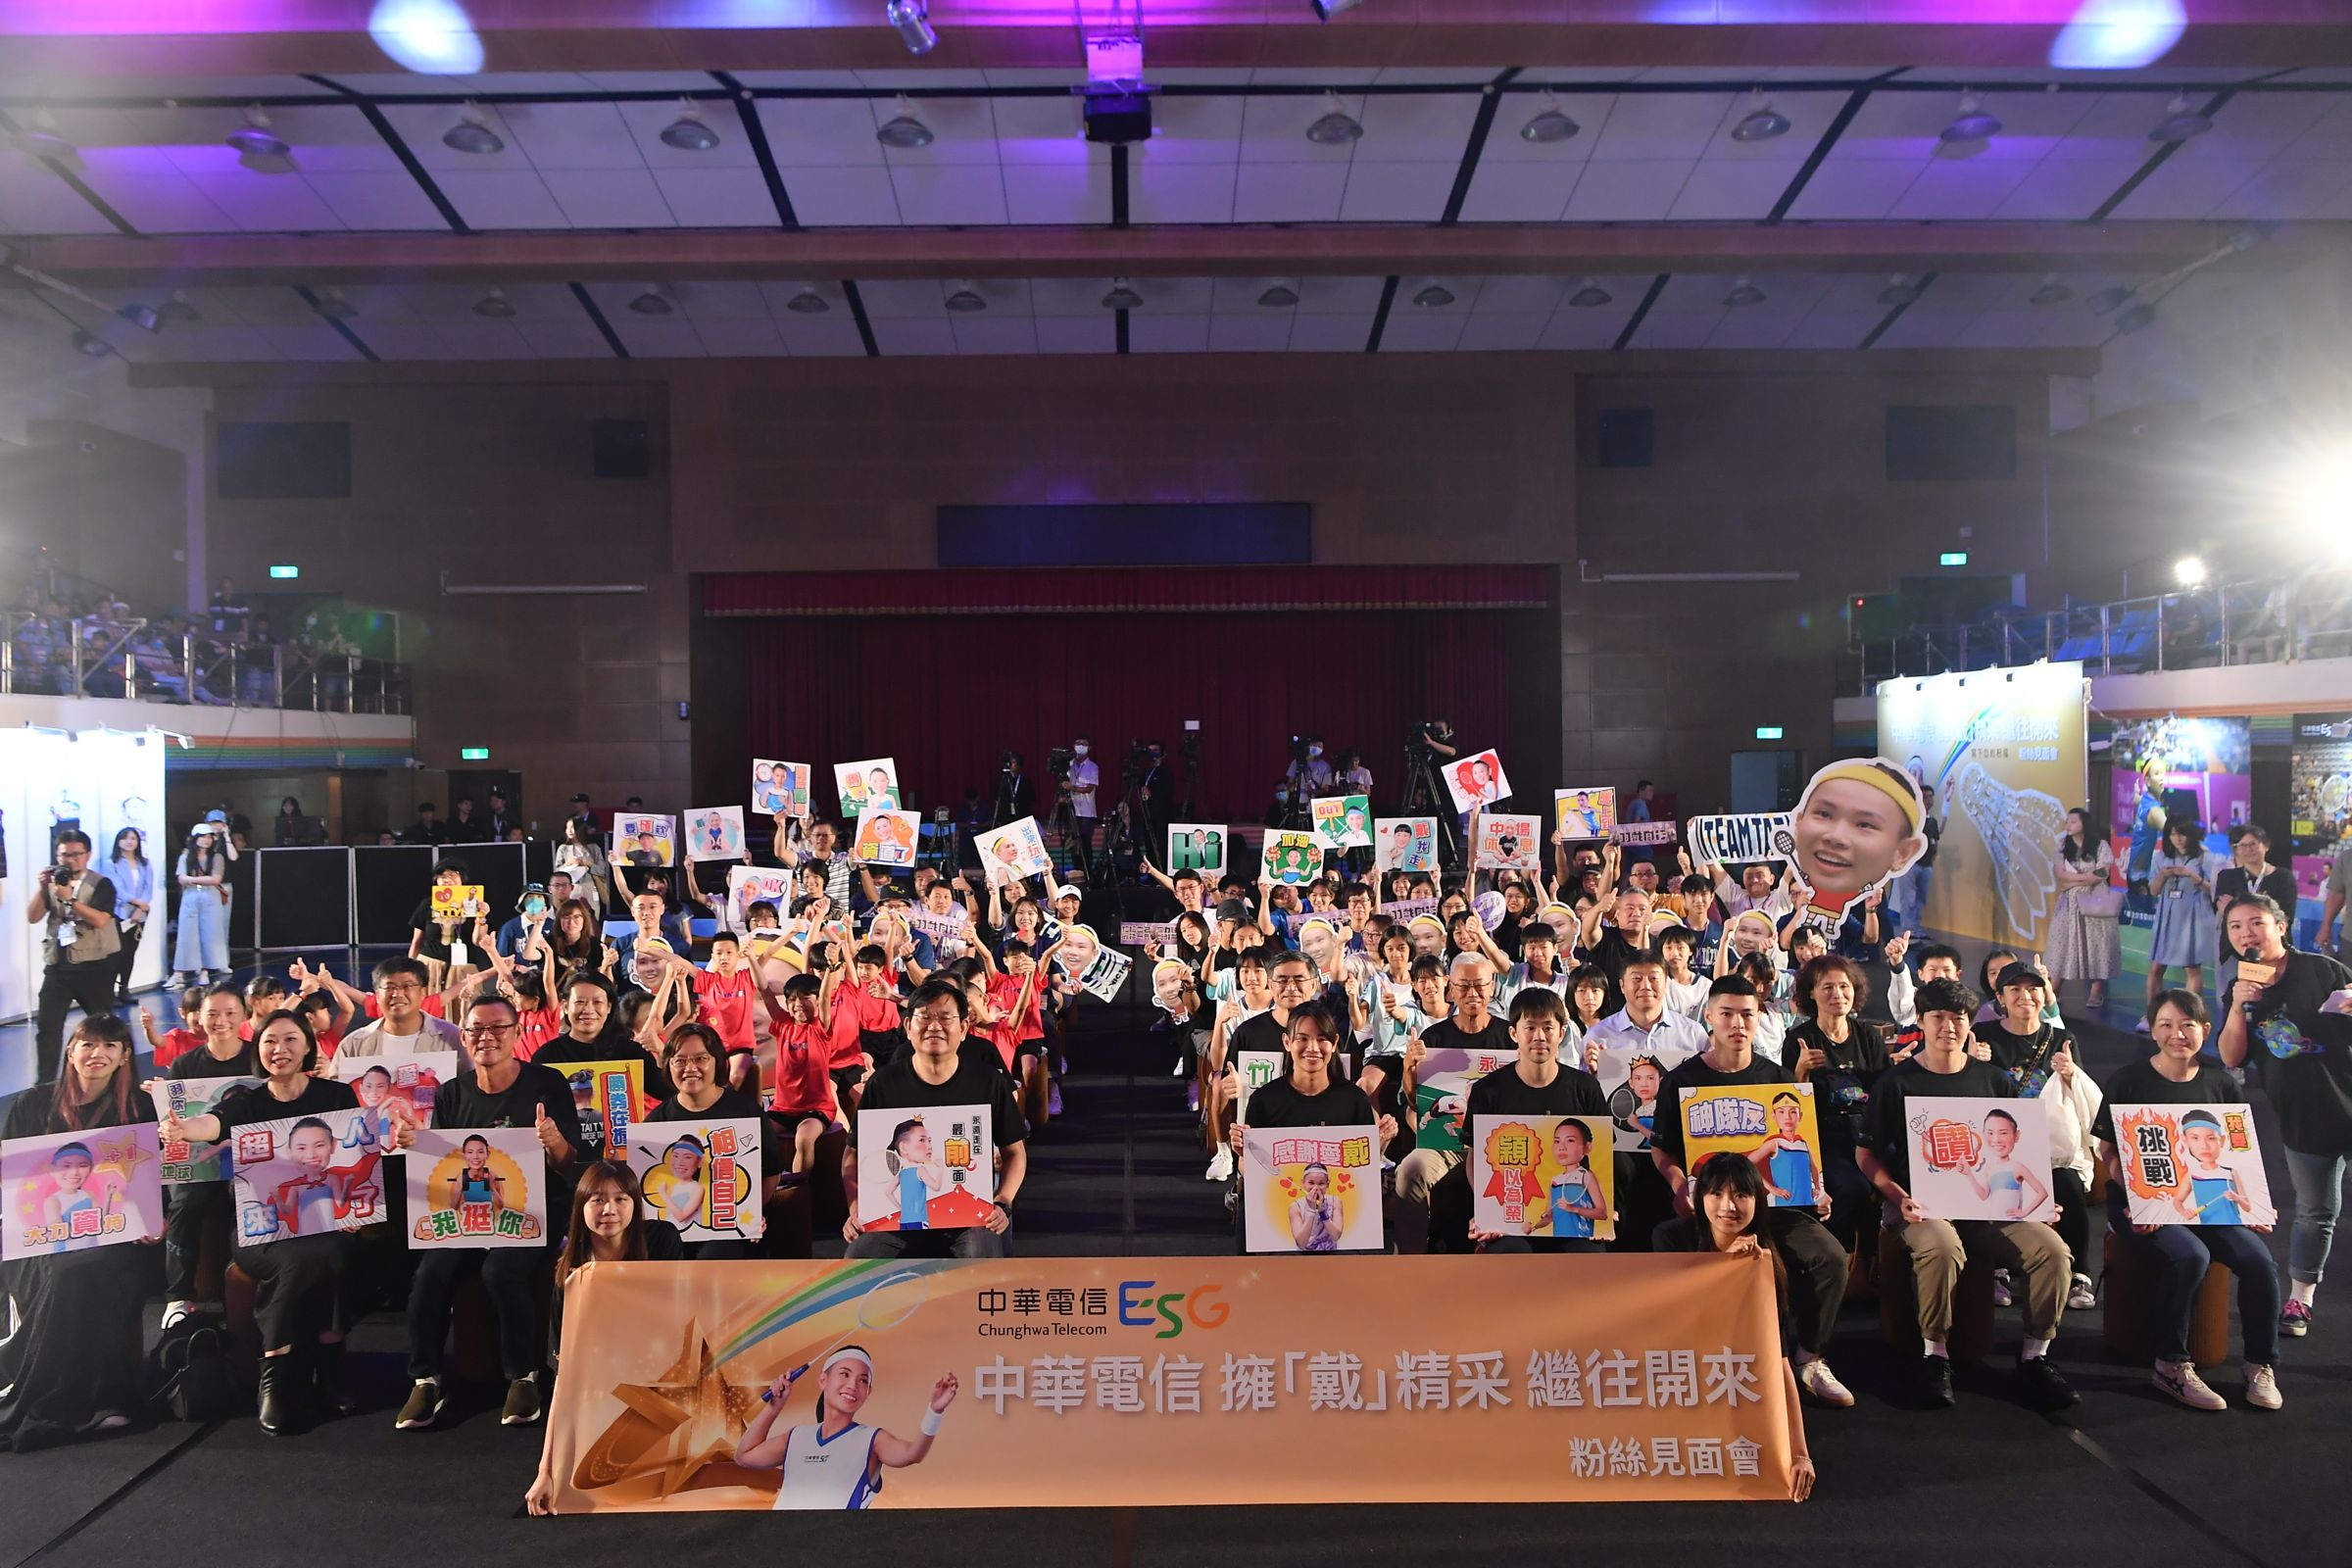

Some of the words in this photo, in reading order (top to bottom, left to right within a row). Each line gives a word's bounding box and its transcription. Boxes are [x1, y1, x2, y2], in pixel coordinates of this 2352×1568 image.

[1318, 805, 1342, 815] OUT
[1172, 830, 1223, 870] Hi
[1280, 833, 1310, 849] 加油
[761, 876, 785, 894] OK
[1689, 1098, 1767, 1136] 神隊友
[104, 1144, 136, 1163] +1
[240, 1131, 273, 1164] 超
[343, 1116, 374, 1149] 人
[945, 1123, 970, 1184] 最前面
[1273, 1137, 1370, 1167] 感謝愛戴
[1932, 1124, 1975, 1164] 讚
[2136, 1126, 2175, 1185] 挑戰
[709, 1127, 737, 1229] 相信自己
[1499, 1136, 1529, 1223] 穎以為榮
[24, 1207, 125, 1247] 大力資持
[244, 1203, 278, 1237] 來
[350, 1185, 379, 1218] 了
[430, 1201, 526, 1240] 我挺你
[978, 1286, 1108, 1316] 中華電信
[1118, 1280, 1230, 1338] ESG
[978, 1322, 1050, 1340] Chunghwa
[1052, 1322, 1108, 1336] Telecom
[973, 1352, 1204, 1417] 中華電信
[1219, 1348, 1512, 1413] 擁「戴」精采
[1526, 1347, 1762, 1410] 繼往開來
[1568, 1434, 1763, 1479] 粉絲見面會
